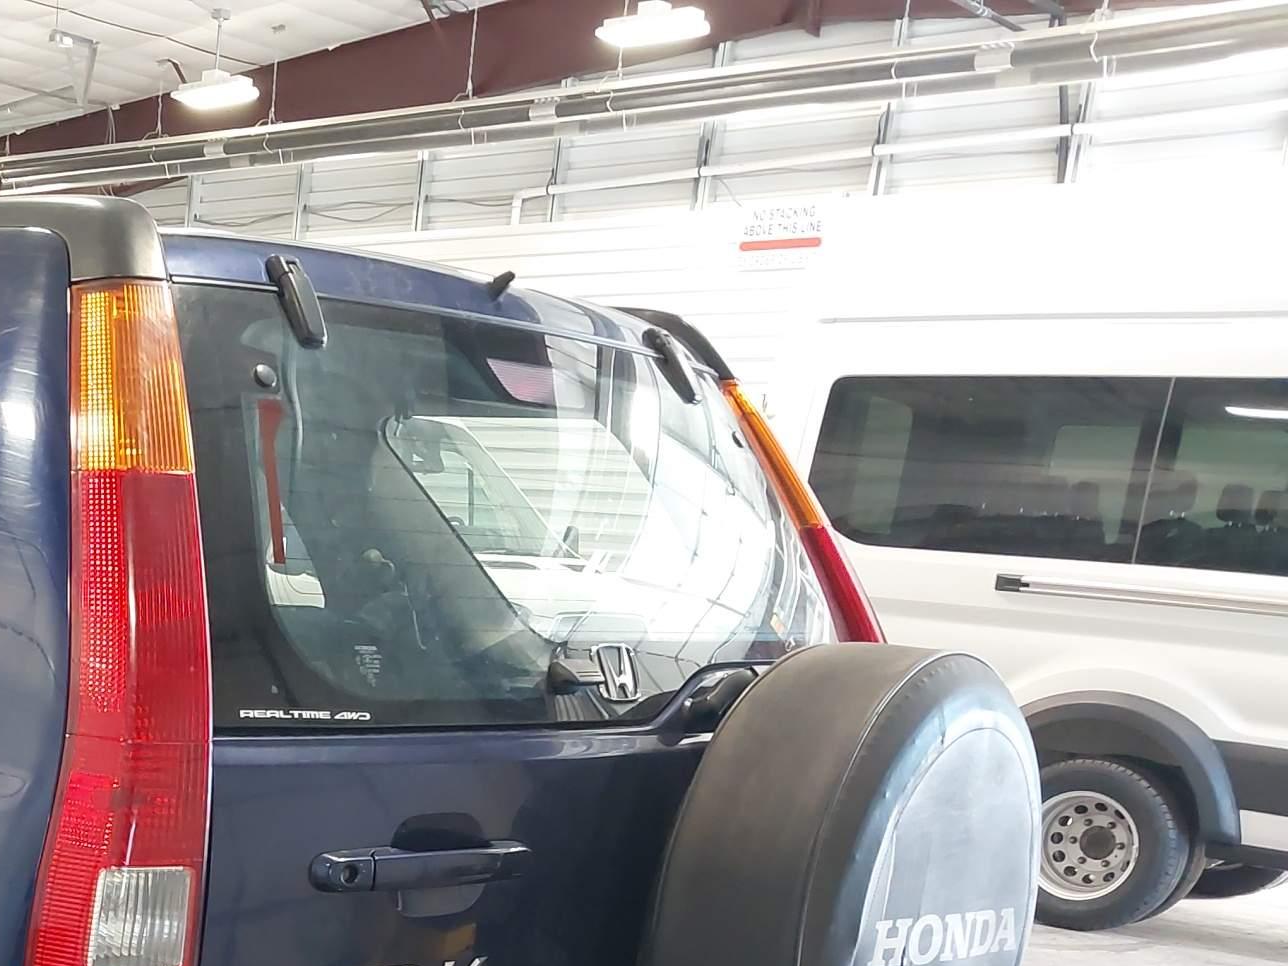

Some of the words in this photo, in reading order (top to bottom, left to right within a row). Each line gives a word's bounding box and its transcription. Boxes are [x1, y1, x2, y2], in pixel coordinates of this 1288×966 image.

[769, 205, 816, 221] STACKING
[743, 223, 773, 236] ABOVE
[776, 222, 798, 234] THIS
[333, 711, 372, 721] 4WD
